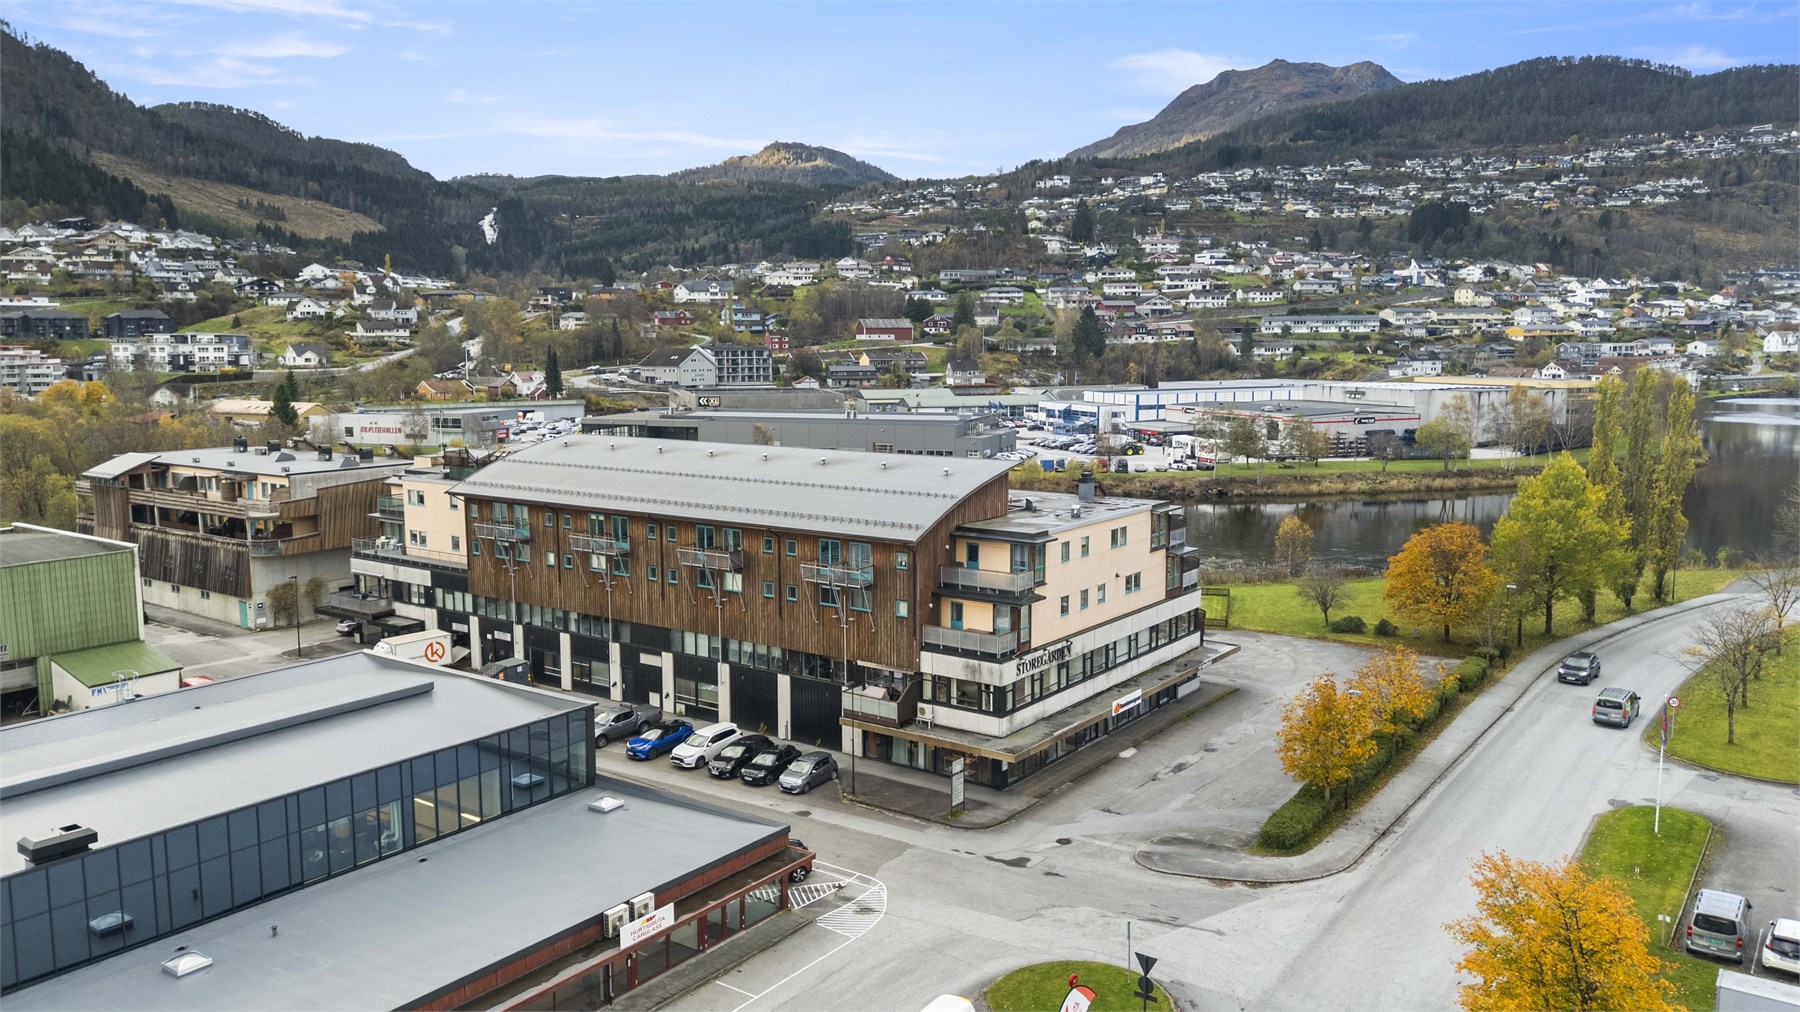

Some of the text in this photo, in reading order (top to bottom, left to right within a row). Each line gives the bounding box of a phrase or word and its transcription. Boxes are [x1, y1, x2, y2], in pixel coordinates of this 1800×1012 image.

[1016, 644, 1072, 677] STOREGÅRDEN
[630, 916, 665, 937] HURTIGRUTA
[632, 924, 662, 941] CARGLASS
